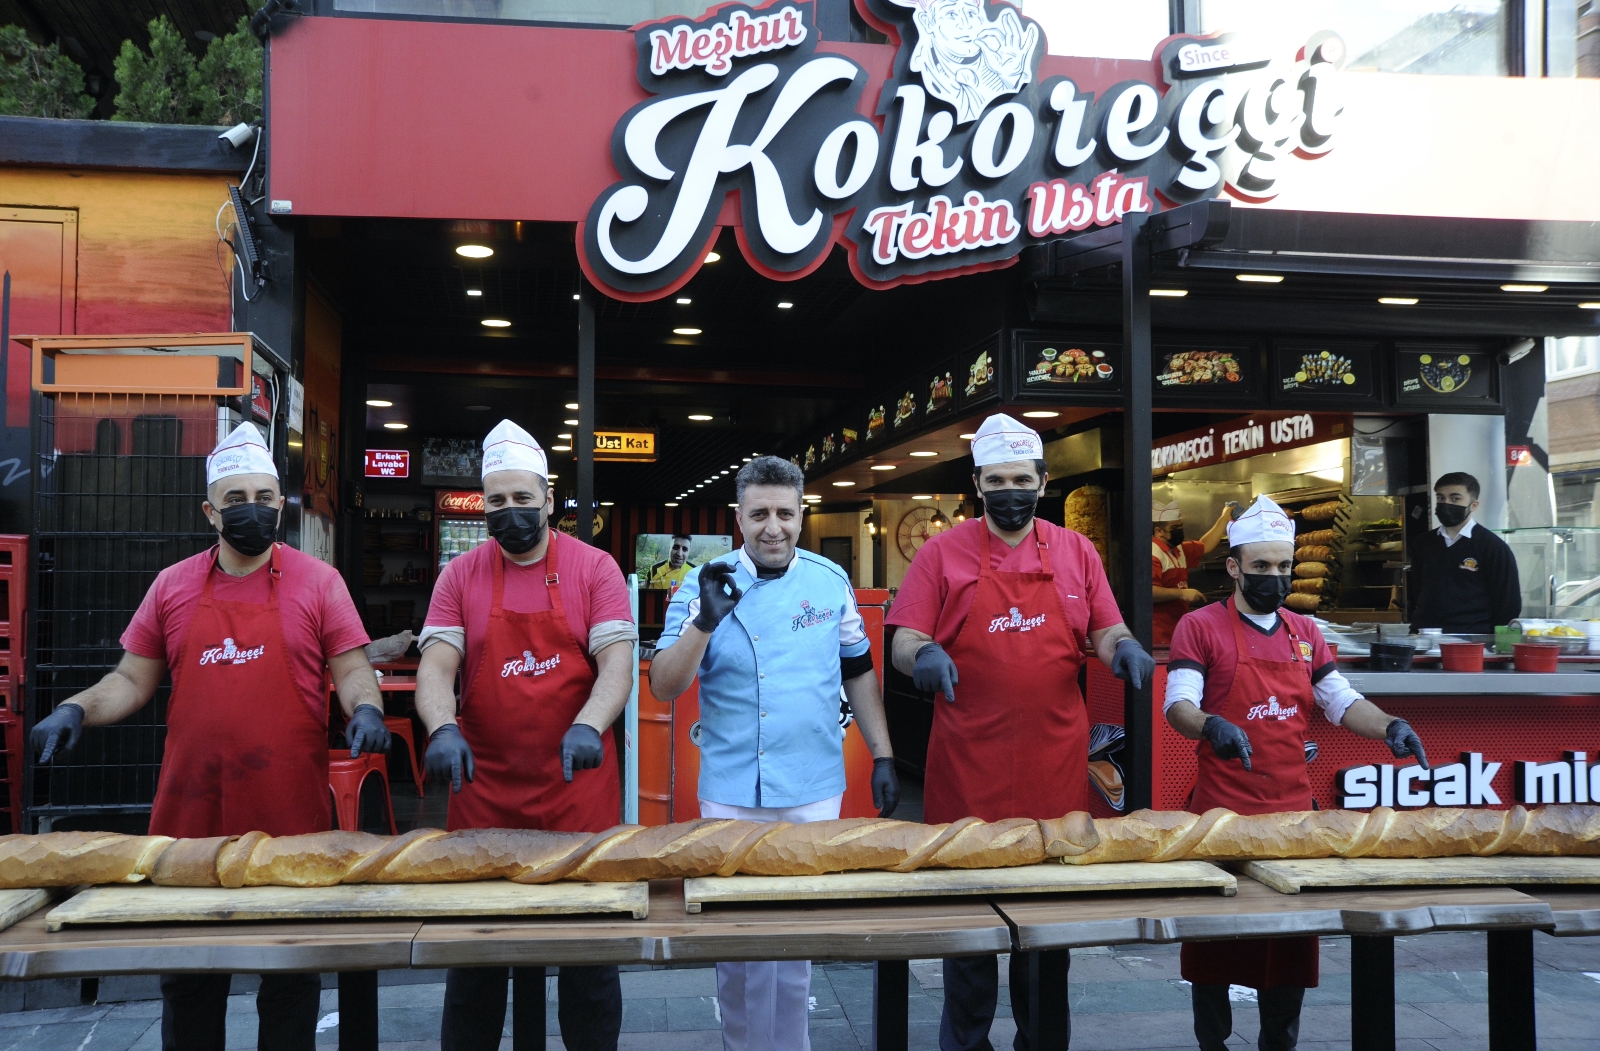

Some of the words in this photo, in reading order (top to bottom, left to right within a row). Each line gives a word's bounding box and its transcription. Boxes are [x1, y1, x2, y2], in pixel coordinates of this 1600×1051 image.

[1184, 49, 1230, 66] Since
[868, 193, 1018, 261] Tekin
[1030, 171, 1152, 235] Usta
[1222, 420, 1264, 455] TEKİN
[1270, 413, 1314, 444] USTA
[596, 436, 621, 449] Üst
[626, 438, 649, 449] Kat
[372, 460, 405, 468] Lavabo
[375, 453, 402, 461] Erkek
[380, 468, 396, 476] WC
[1524, 751, 1600, 804] mi
